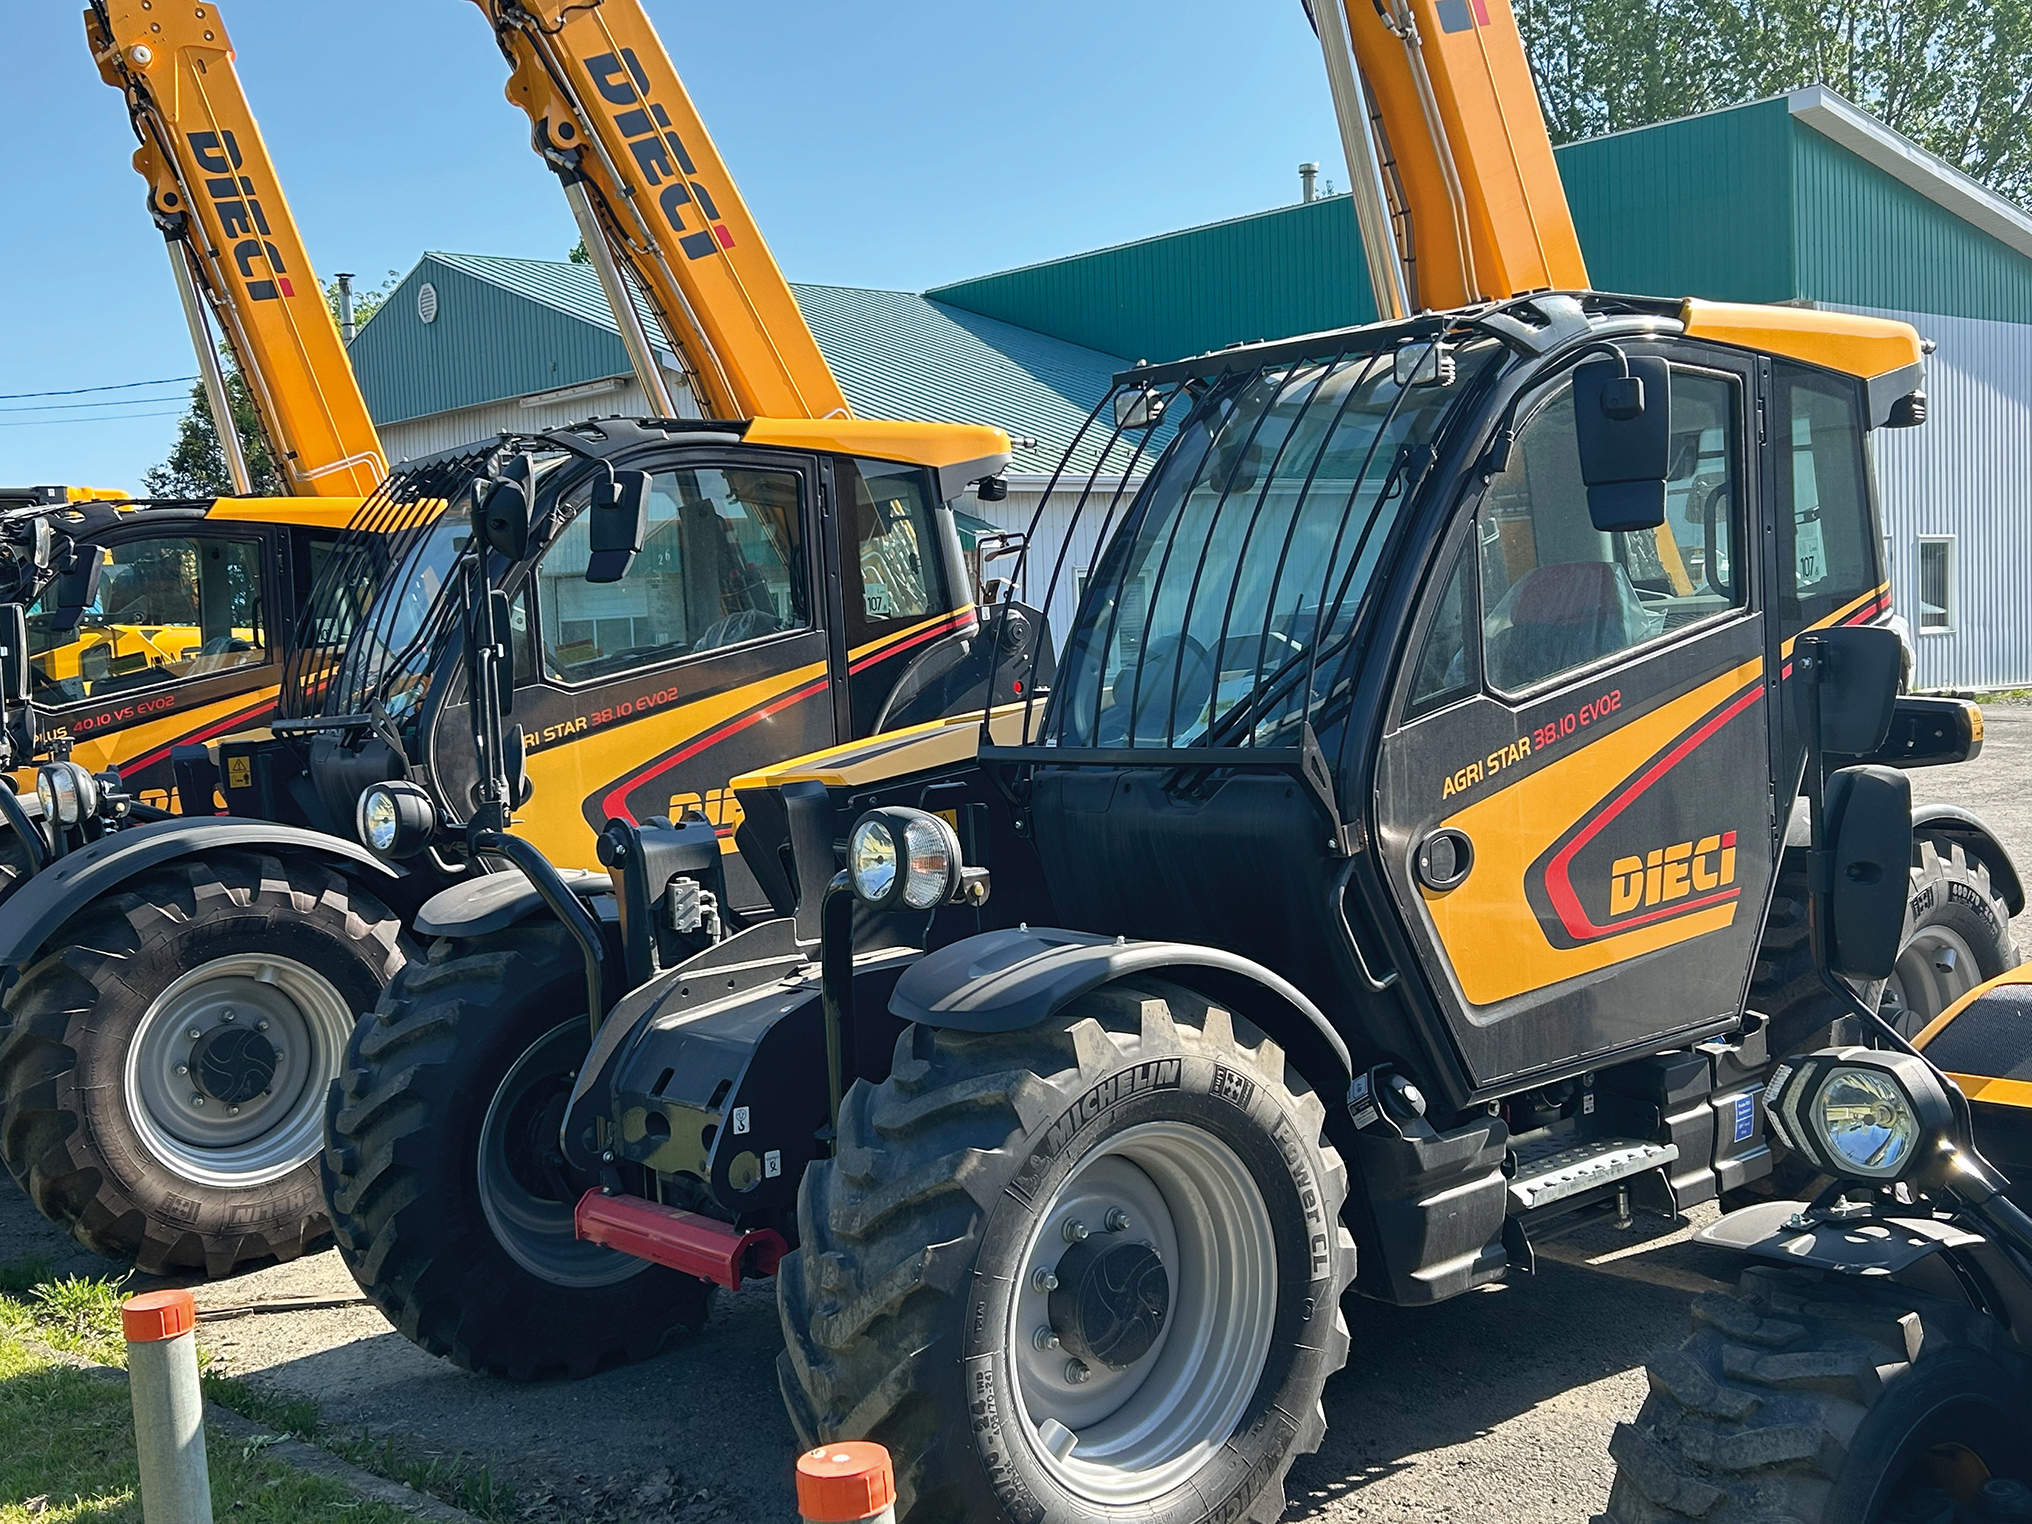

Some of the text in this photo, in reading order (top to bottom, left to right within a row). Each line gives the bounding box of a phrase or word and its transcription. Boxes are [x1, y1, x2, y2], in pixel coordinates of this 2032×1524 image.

[583, 47, 736, 261] DIECI
[186, 129, 296, 302] DIECI
[867, 596, 883, 612] 107
[1800, 556, 1815, 578] 107
[73, 712, 113, 732] 40.10
[113, 706, 135, 722] VS
[136, 695, 176, 715] EVO2
[524, 687, 680, 749] RI STAR 38.10 EVO2
[1442, 689, 1622, 801] AGRI STAR 38.10 EVO2
[1610, 830, 1737, 917] DIECI
[1047, 1060, 1181, 1150] MICHELIN
[1311, 1233, 1329, 1274] CL
